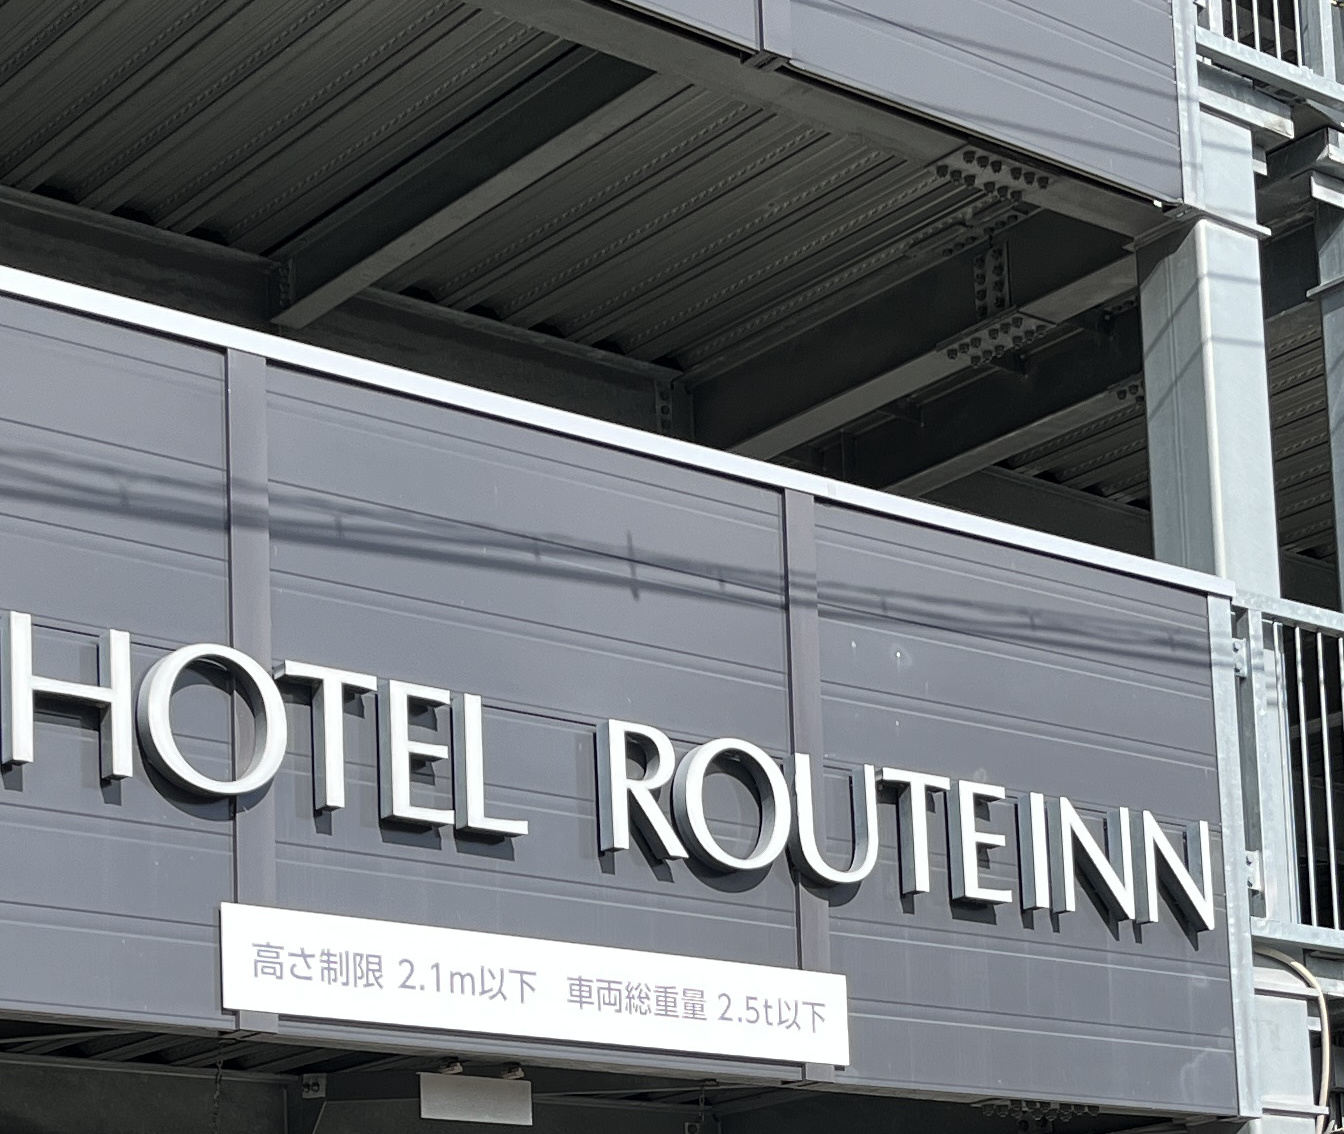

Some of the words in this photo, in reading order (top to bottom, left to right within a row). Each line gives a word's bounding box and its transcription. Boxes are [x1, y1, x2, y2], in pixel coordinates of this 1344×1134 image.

[597, 716, 1214, 932] ROUTEINN
[251, 941, 385, 990] 高さ制限
[397, 958, 538, 1005] 2.1m以下
[566, 975, 708, 1022] 車両総重量
[717, 991, 827, 1035] 2.5t以下
